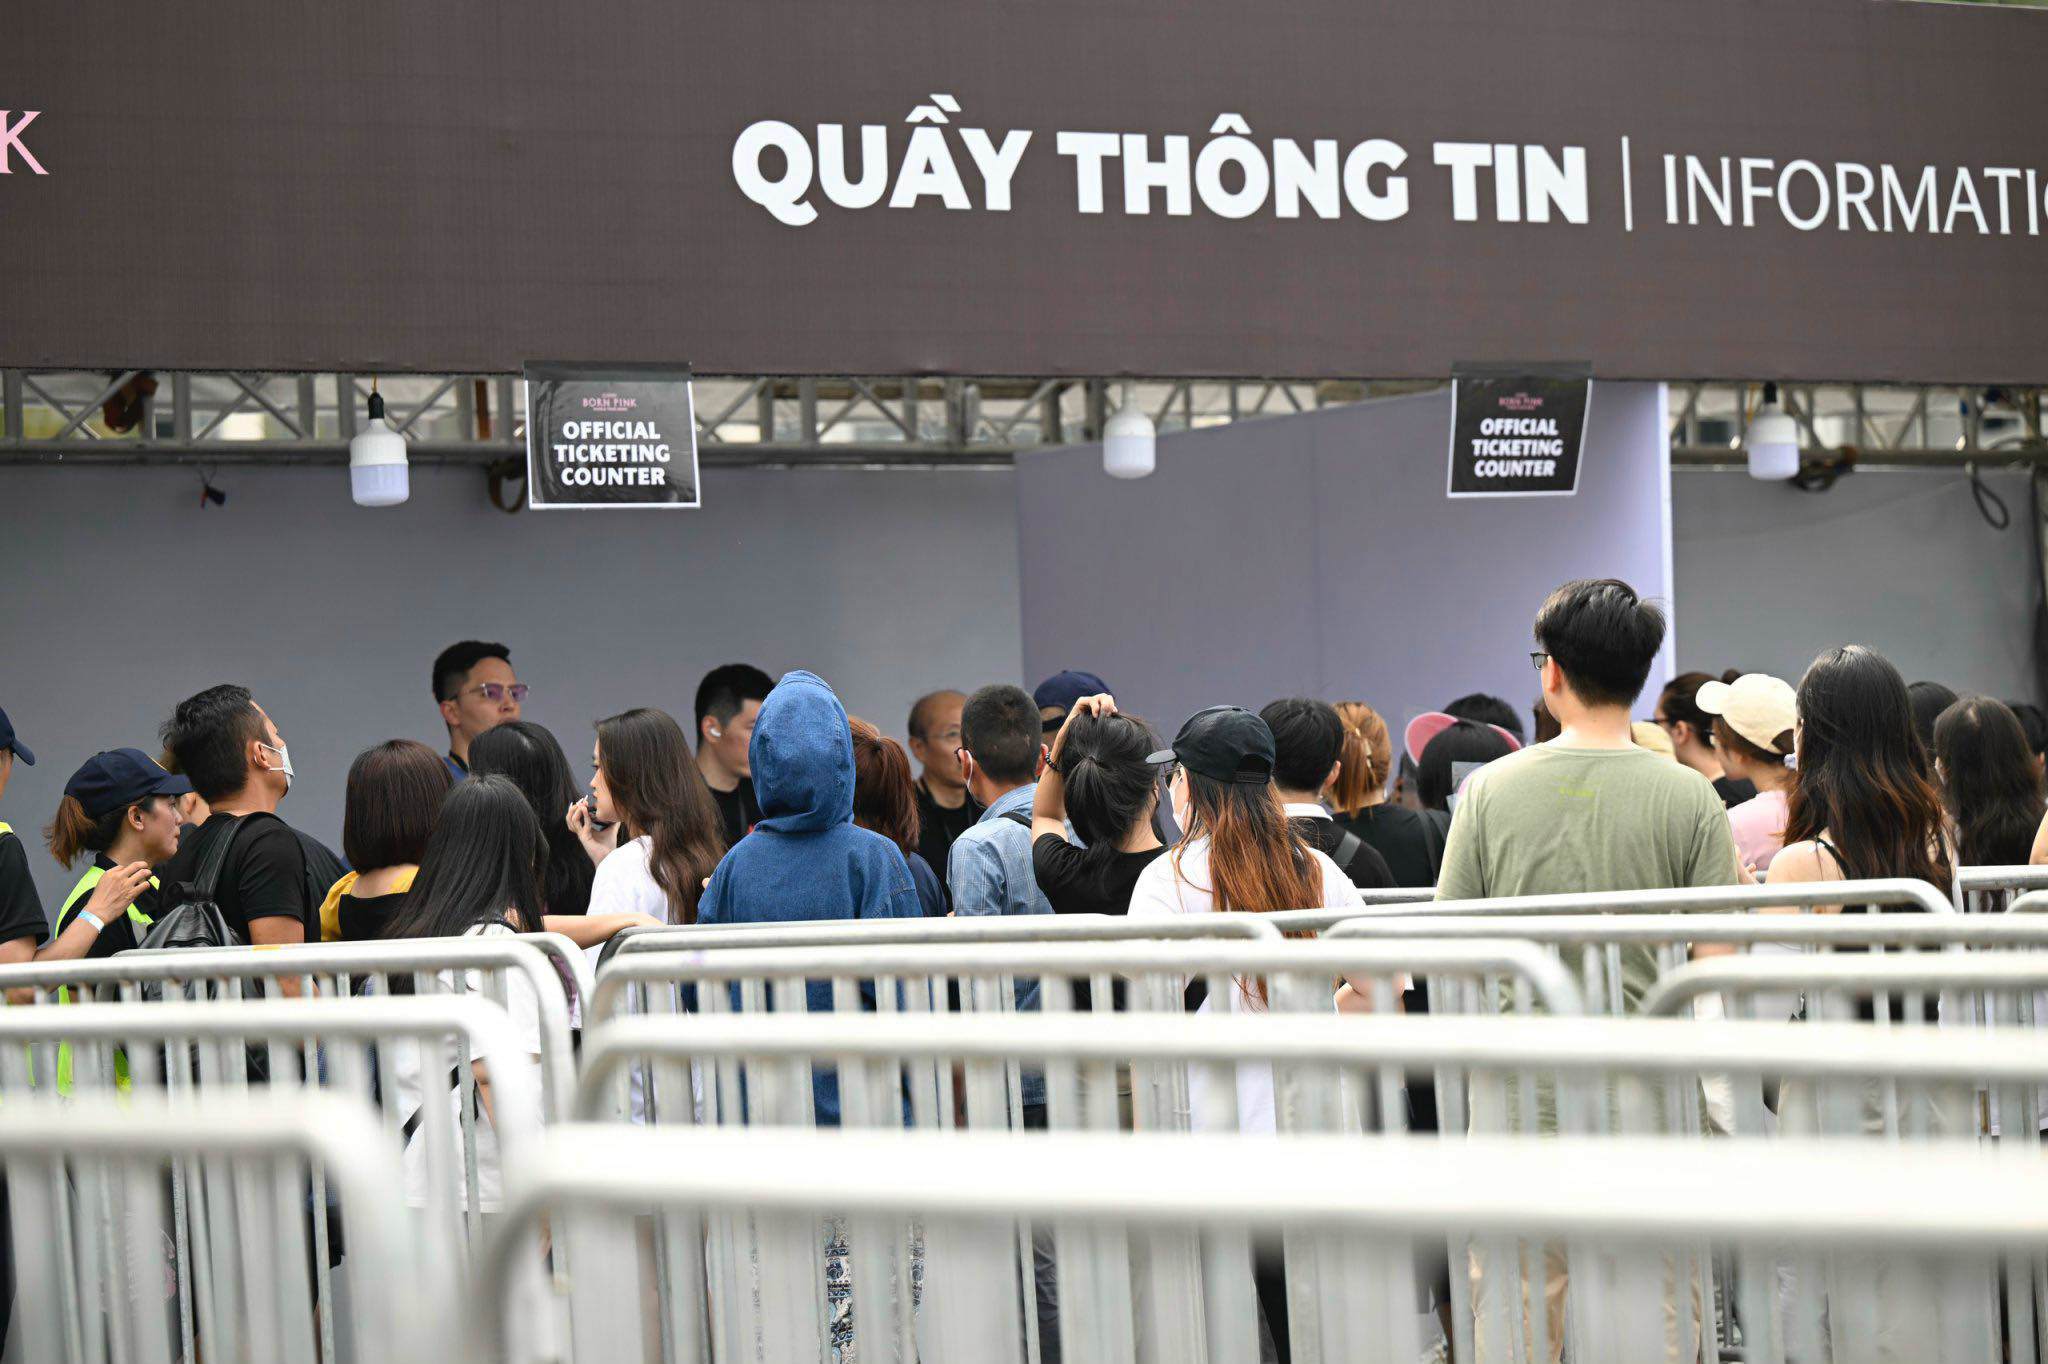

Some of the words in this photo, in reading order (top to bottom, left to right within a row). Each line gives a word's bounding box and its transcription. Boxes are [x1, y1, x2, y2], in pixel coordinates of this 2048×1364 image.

[733, 94, 1032, 226] QUẦY
[1057, 114, 1409, 221] THÔNG
[1433, 142, 1588, 224] TIN
[1664, 154, 2048, 235] INFORMATI
[563, 421, 661, 440] OFFICIAL
[1480, 418, 1559, 436] OFFICIAL
[554, 444, 671, 463] TICKETING
[1472, 439, 1563, 457] TICKETING
[561, 467, 665, 485] COUNTER
[1474, 460, 1555, 477] COUNTER
